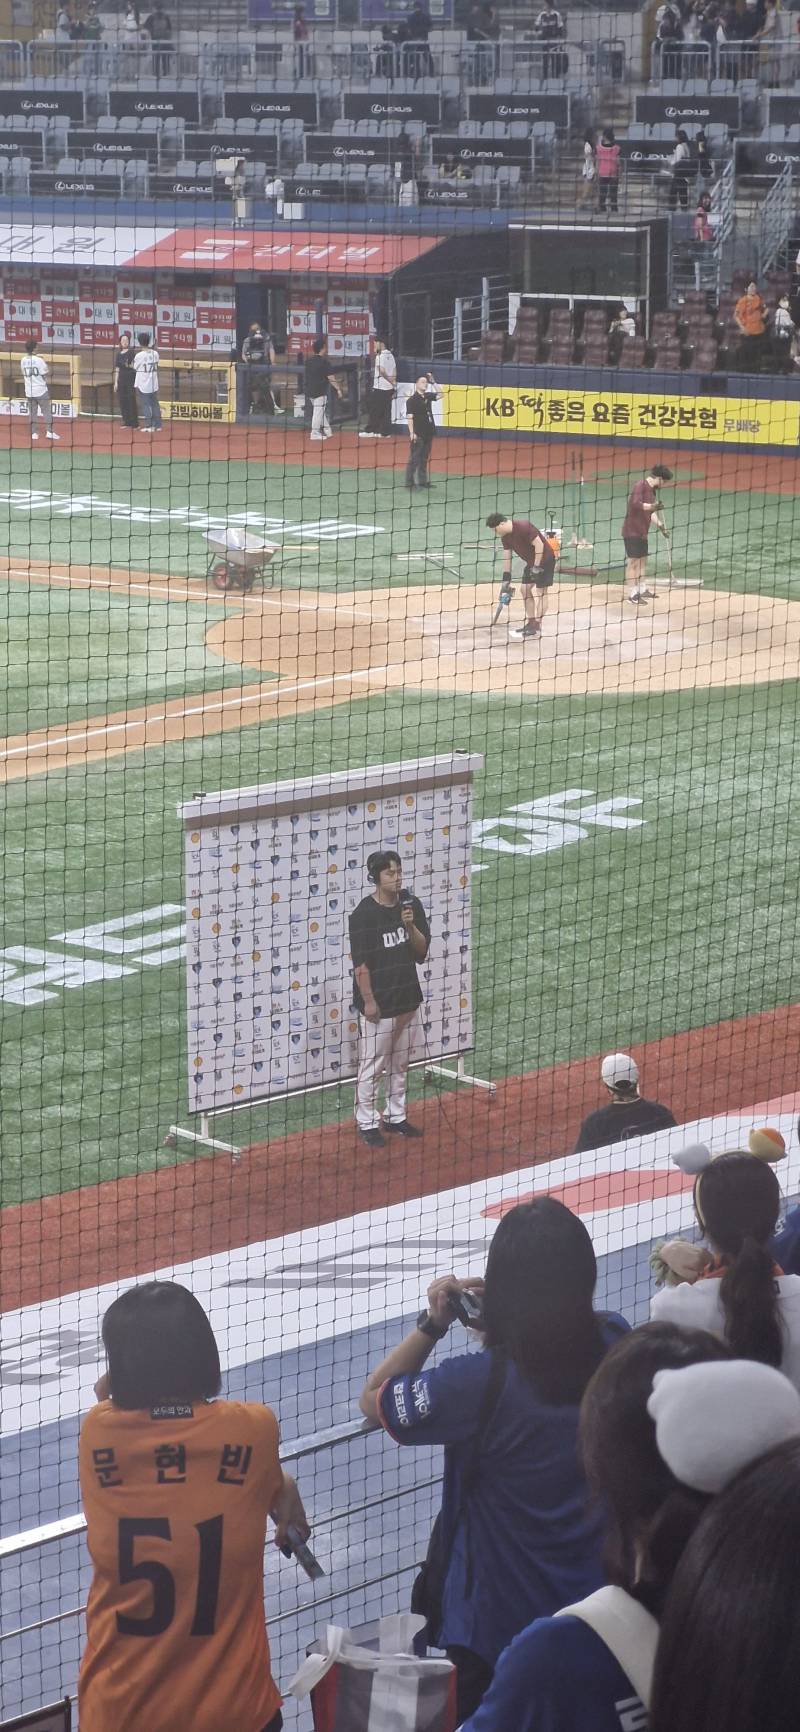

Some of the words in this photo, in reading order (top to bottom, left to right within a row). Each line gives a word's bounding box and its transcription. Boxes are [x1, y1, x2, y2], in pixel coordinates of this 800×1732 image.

[486, 398, 515, 417] KB
[638, 404, 717, 429] 건강보험
[724, 419, 760, 433] 무배당
[115, 1513, 224, 1637] 51
